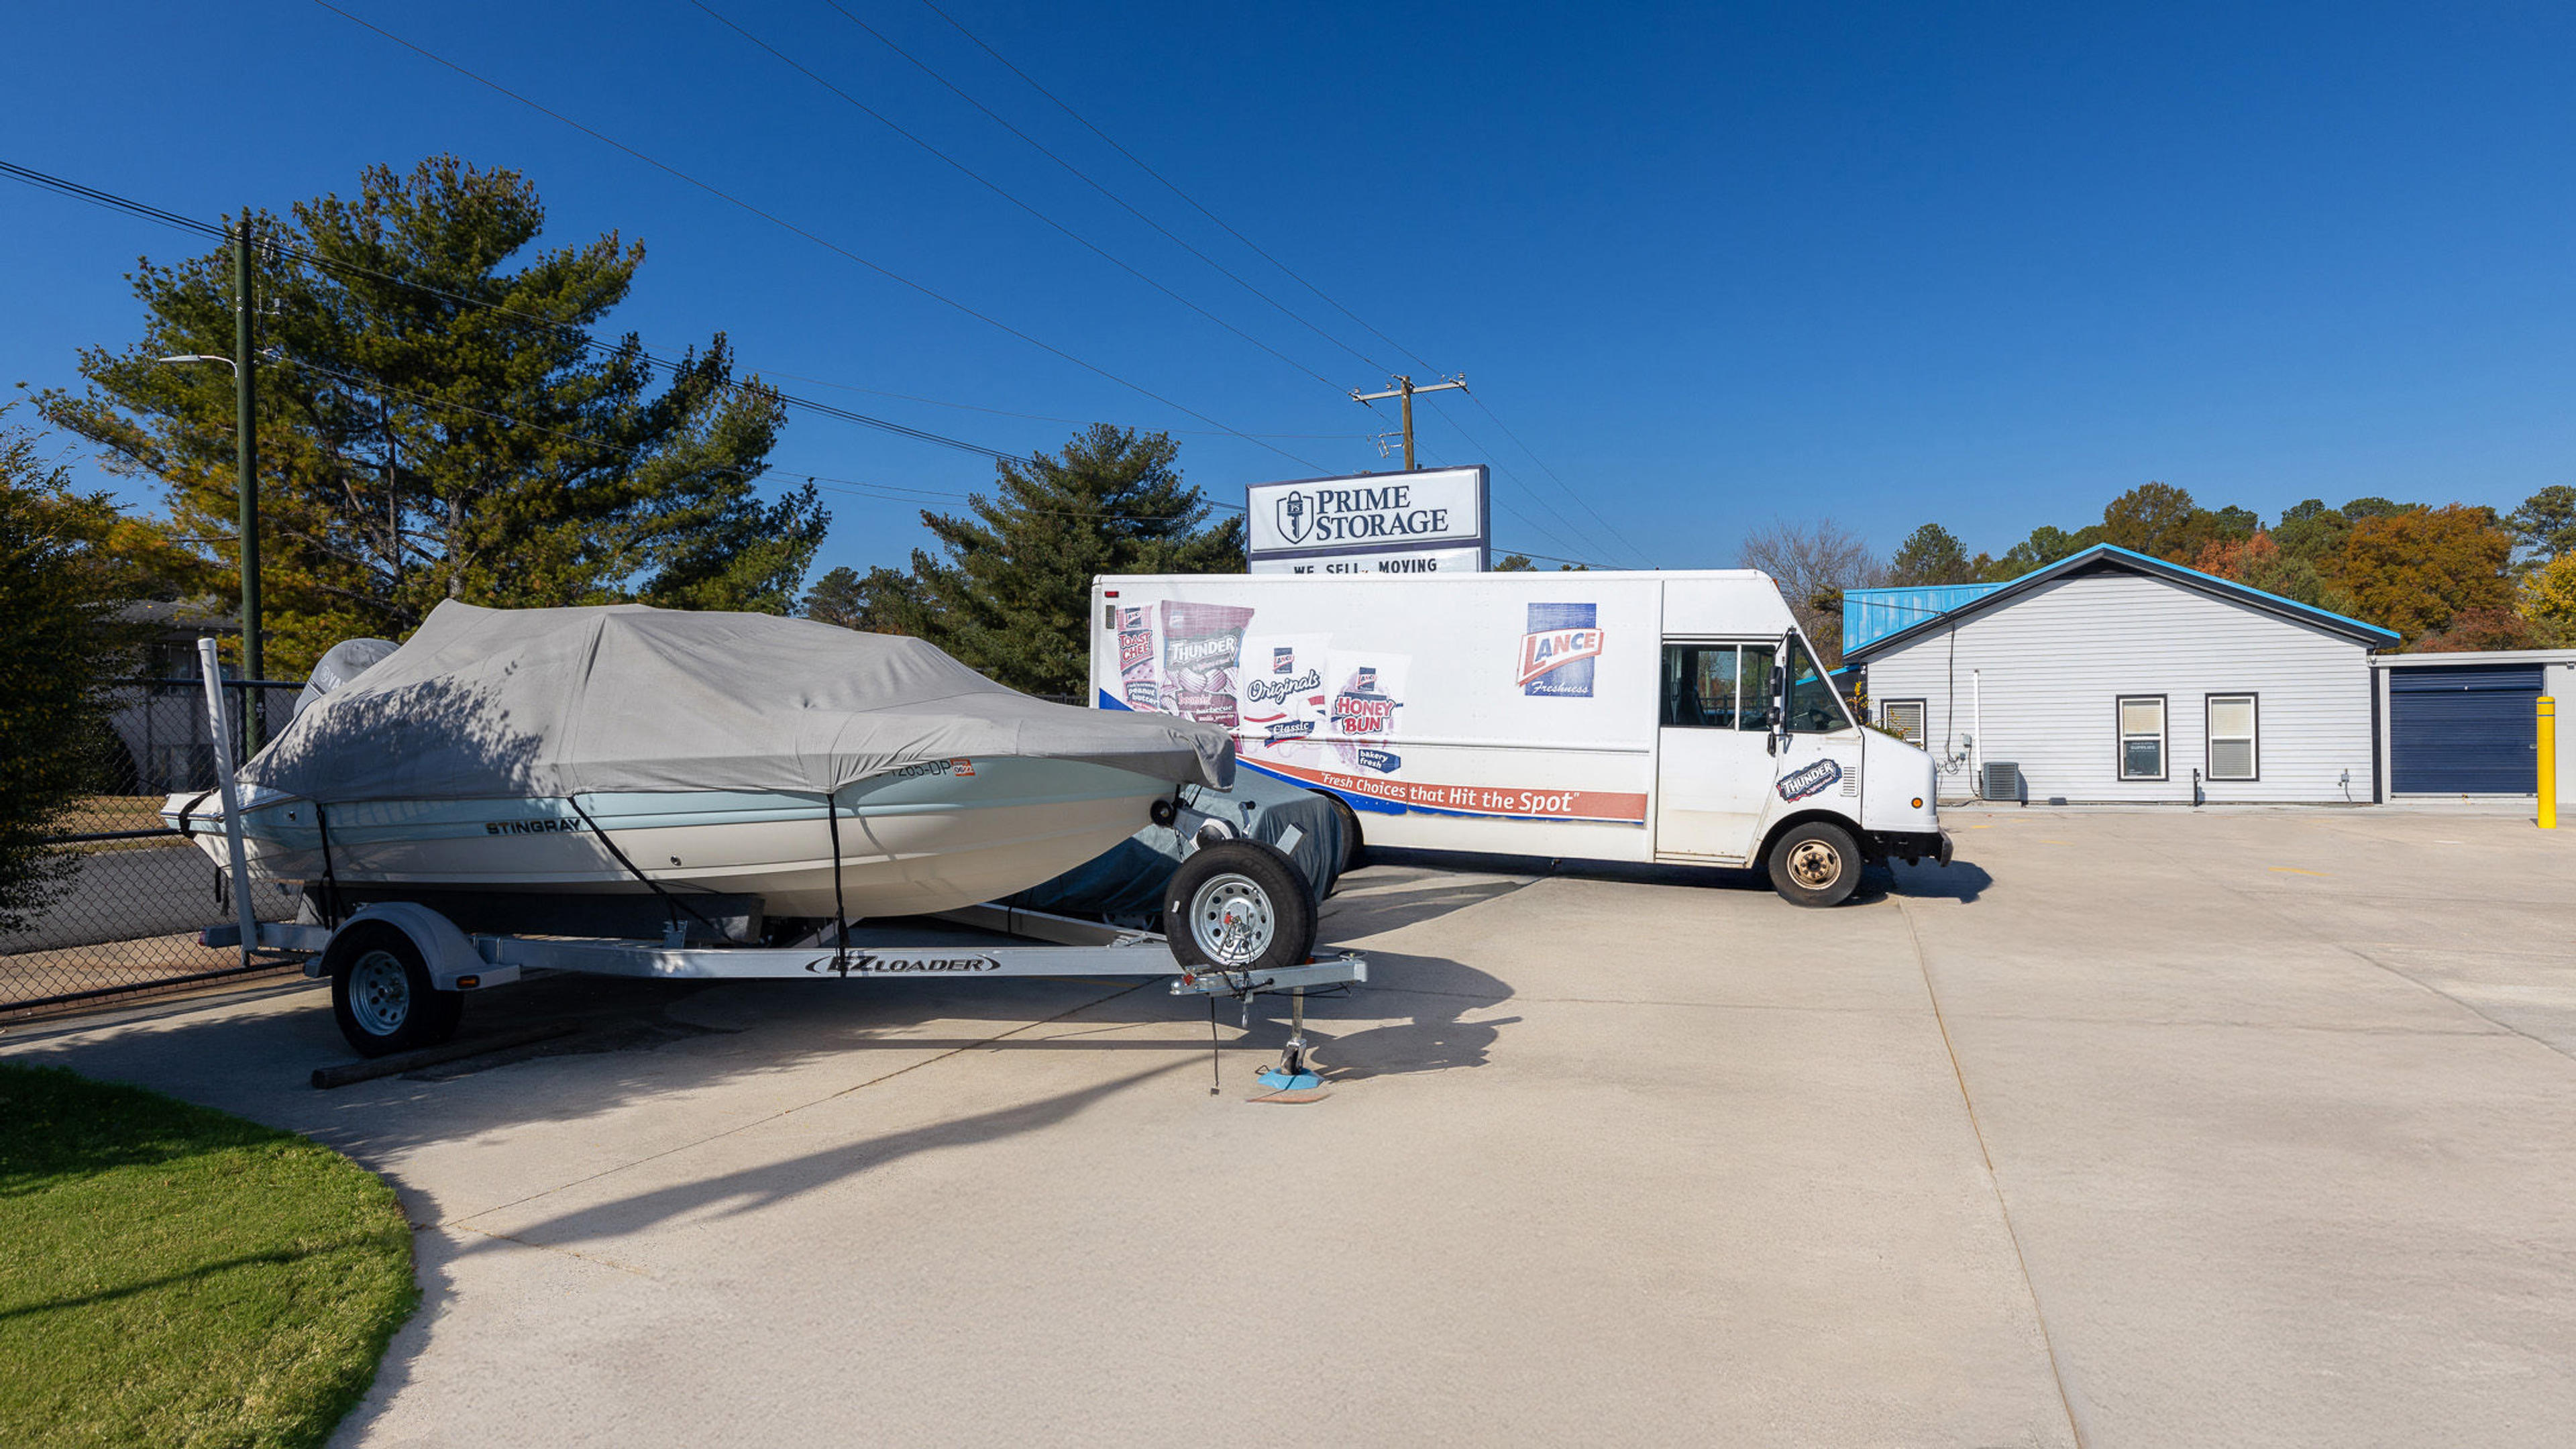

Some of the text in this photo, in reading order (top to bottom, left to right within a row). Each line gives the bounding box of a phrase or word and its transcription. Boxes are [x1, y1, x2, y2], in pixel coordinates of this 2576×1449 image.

[1316, 485, 1410, 515] PRIME
[1316, 508, 1449, 541] STORAGE
[1294, 558, 1437, 574] WE SELL MOVING
[1119, 631, 1150, 647] TOAST
[1171, 636, 1235, 661] THUNDER
[1122, 642, 1149, 661] CHEE
[1523, 632, 1596, 676] LANCE
[1248, 669, 1321, 704] Originals
[1531, 680, 1589, 694] Freshness
[1336, 697, 1394, 716] HONEY
[1273, 721, 1309, 735] Classic
[1344, 716, 1381, 733] BUN
[1360, 749, 1389, 763] bakery
[1360, 757, 1382, 769] fresh
[1782, 761, 1836, 795] THUNDER
[1321, 772, 1580, 816] "Fresh Choices that Hit the Spot"
[485, 818, 581, 835] STINGRAY
